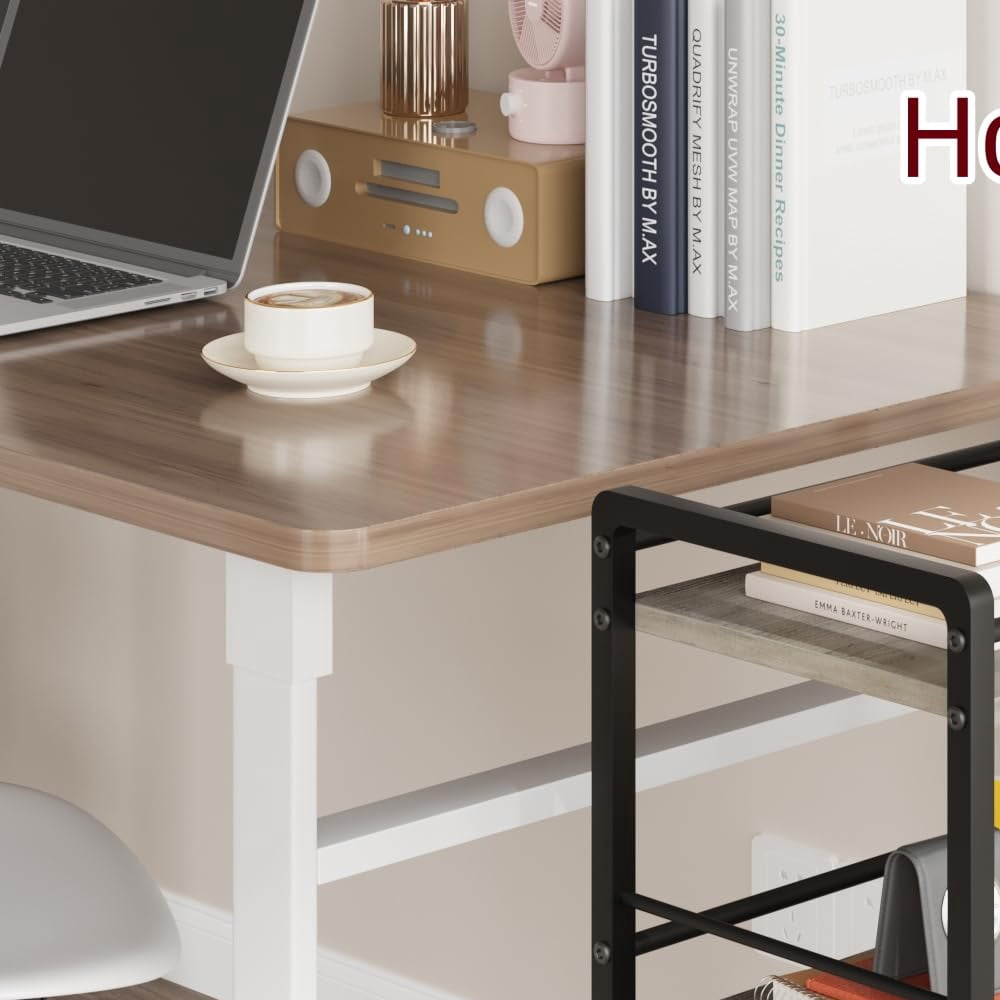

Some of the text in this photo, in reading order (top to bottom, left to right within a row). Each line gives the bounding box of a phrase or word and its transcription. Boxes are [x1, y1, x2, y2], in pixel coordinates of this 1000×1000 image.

[641, 33, 659, 266] TURBOSMOOTH BY M.AX
[691, 27, 703, 276] QUADRIFY MESH BY M.AX
[727, 47, 739, 313] UNWRAP UVW MAP BY M.AX
[773, 13, 787, 283] 30-Minute Dinner Recipes
[814, 599, 909, 633] EMMA BAXTER-WRIGHT
[834, 514, 908, 549] LE NOIR
